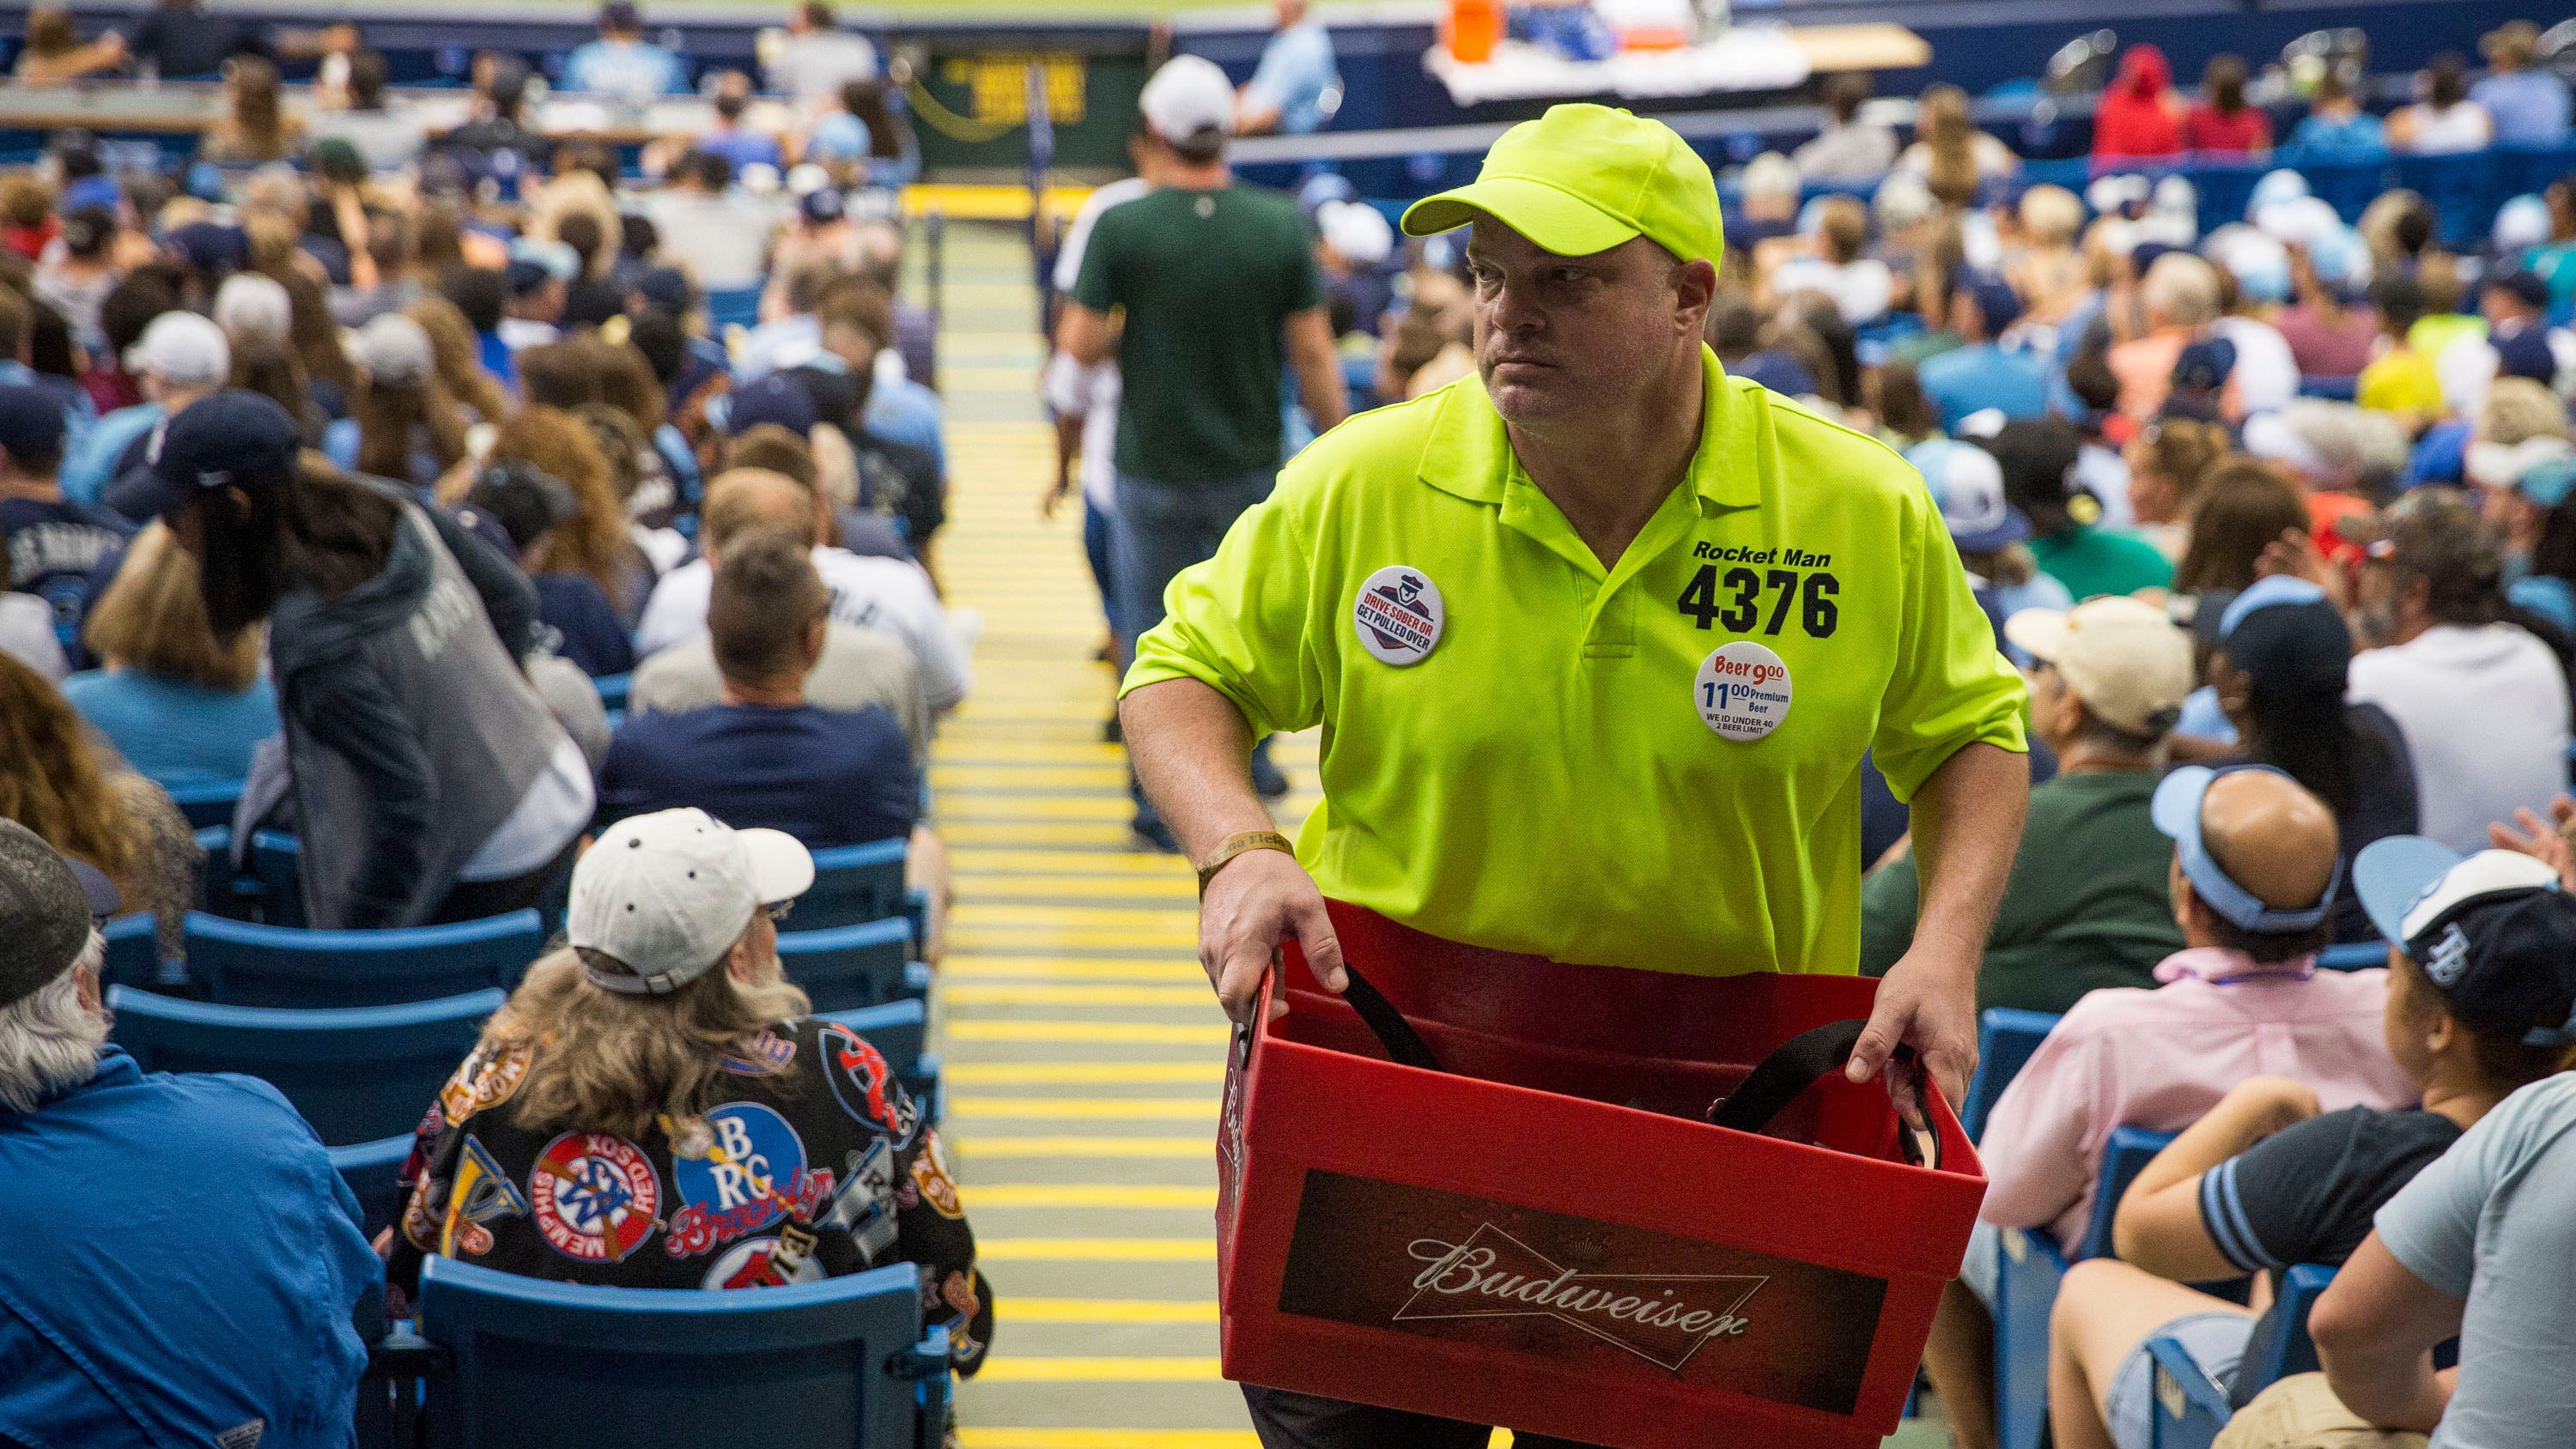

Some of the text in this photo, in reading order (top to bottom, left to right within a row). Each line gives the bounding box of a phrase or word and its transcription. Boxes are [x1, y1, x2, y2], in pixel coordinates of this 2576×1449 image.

[1692, 540, 1832, 567] Rocket Man
[1364, 591, 1434, 637] DRIVE SOBER OR
[1677, 564, 1839, 639] 4376
[1357, 603, 1431, 651] GET PULLED OVER
[1714, 655, 1752, 676] Beer
[1748, 701, 1769, 714] Beer
[1750, 688, 1789, 703] Premium
[1706, 712, 1720, 722] WE
[1732, 716, 1762, 727] UNDER
[1763, 719, 1773, 728] 40
[1722, 724, 1741, 732] BEER
[1742, 725, 1765, 735] LIMIT
[718, 1116, 753, 1160] B
[532, 1170, 606, 1258] MEMPHIS
[1406, 1238, 1750, 1337] Budweiser
